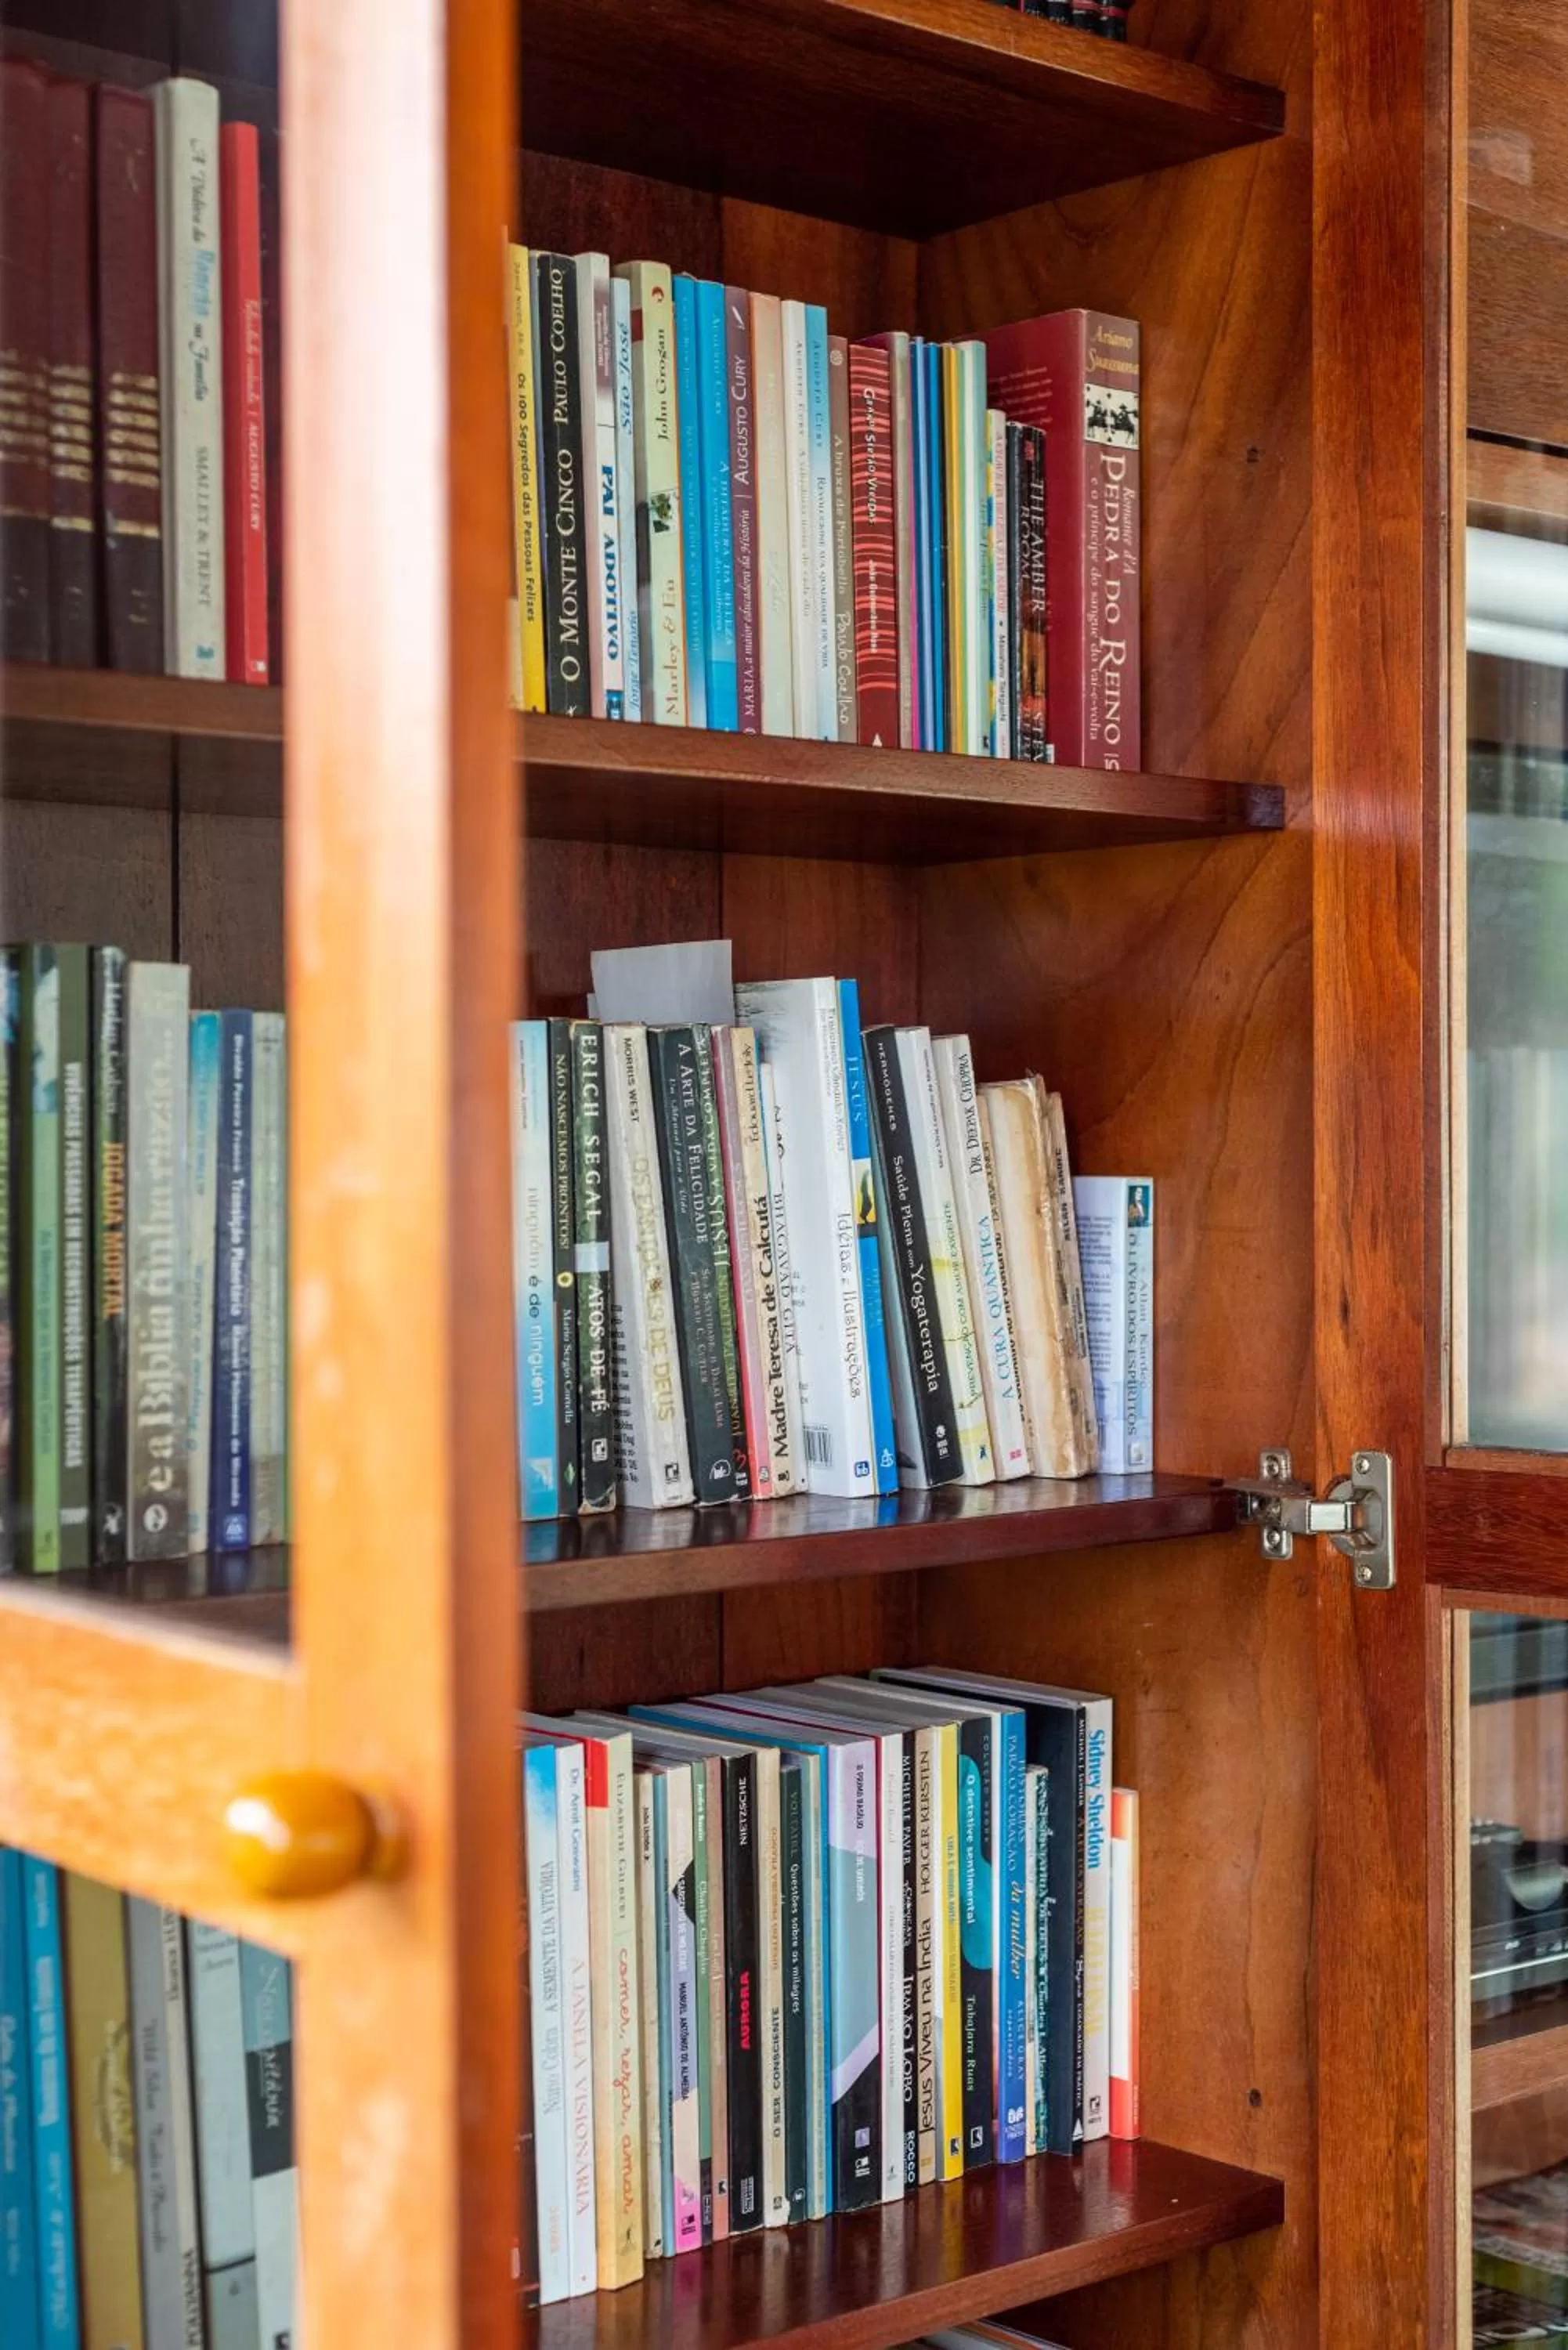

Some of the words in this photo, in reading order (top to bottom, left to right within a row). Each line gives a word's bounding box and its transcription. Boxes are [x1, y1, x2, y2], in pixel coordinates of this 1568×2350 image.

[550, 267, 566, 352] COELHO
[616, 320, 631, 376] José
[656, 327, 668, 394] Grogan
[553, 360, 569, 425] PAULO
[732, 354, 747, 401] CURY
[619, 386, 632, 436] São
[656, 400, 670, 441] John
[517, 424, 529, 486] Segredos
[734, 407, 750, 484] AUGUSTO
[522, 492, 532, 515] das
[556, 449, 576, 535] CINCO
[601, 465, 615, 517] PAI
[1030, 479, 1045, 526] THE
[1090, 490, 1099, 499] o
[1100, 451, 1126, 562] PEDRA
[1122, 486, 1135, 546] Romance
[522, 520, 533, 572] Pessoas
[559, 546, 579, 645] MONTE
[604, 532, 618, 661] ADOTIVO
[662, 578, 676, 609] Eu
[739, 570, 753, 622] educadora
[1030, 531, 1046, 615] AMBER
[1090, 567, 1101, 586] do
[525, 577, 535, 622] Felizes
[663, 616, 676, 634] &
[1086, 591, 1100, 639] sangue
[1104, 579, 1122, 624] DO
[836, 610, 852, 660] Paulo
[1089, 643, 1101, 662] do
[561, 656, 580, 682] O
[663, 638, 680, 715] Marley
[837, 664, 852, 725] Coelho
[1098, 638, 1127, 745] REINO
[1089, 668, 1101, 740] vai-e-volta
[555, 1054, 568, 1086] NÃO
[580, 1034, 599, 1118] ERICH
[623, 1037, 635, 1086] MORRIS
[677, 1043, 691, 1057] A
[680, 1065, 695, 1108] ARTE
[877, 1041, 897, 1132] HERMÓGENES
[958, 1053, 972, 1103] CHOPRA
[556, 1090, 568, 1172] NASCEMOS
[627, 1088, 640, 1123] WEST
[685, 1115, 698, 1137] DA
[963, 1104, 980, 1150] DEEPAK
[707, 1130, 718, 1172] VIDA
[102, 1141, 125, 1225] JOGADA
[584, 1134, 602, 1224] SEGAL
[687, 1143, 709, 1245] FELICIDADE
[893, 1155, 908, 1201] Saúde
[708, 1193, 731, 1267] JESUS
[753, 1195, 773, 1278] Calcutá
[900, 1204, 912, 1246] Plena
[102, 1231, 125, 1321] MORTAL
[761, 1284, 777, 1311] de
[1128, 1252, 1137, 1304] LIVRO
[528, 1293, 542, 1318] de
[588, 1284, 605, 1339] ATOS
[909, 1264, 940, 1394] Yogaterapia
[1127, 1310, 1137, 1344] DOS
[528, 1325, 545, 1406] ninguém
[589, 1349, 605, 1378] DE
[763, 1316, 782, 1386] Teresa
[993, 1325, 1011, 1379] CURA
[563, 1380, 573, 1424] Cortella
[591, 1389, 610, 1413] FÉ
[1002, 1386, 1014, 1400] A
[771, 1386, 789, 1458] Madre
[966, 1774, 974, 1784] O
[1086, 1729, 1105, 1789] Sidney
[738, 1777, 748, 1846] NIETZSCHE
[919, 1751, 930, 1824] KERSTEN
[965, 1788, 976, 1843] detetive
[1086, 1794, 1104, 1870] Sheldon
[920, 1828, 930, 1894] HOLGER
[966, 1846, 976, 1925] sentimental
[789, 1864, 800, 1914] Questões
[542, 1916, 555, 1935] DA
[791, 1917, 801, 1947] sobre
[739, 1970, 751, 2050] AURORA
[790, 1966, 802, 2015] milagres
[921, 1973, 934, 2005] na
[771, 2006, 781, 2090] CONSCIENTE
[919, 2012, 934, 2071] Viveu
[963, 1994, 977, 2054] Tabajara
[966, 2059, 977, 2092] Ruas
[920, 2080, 934, 2131] Jesus
[906, 2130, 916, 2183] ROCCO
